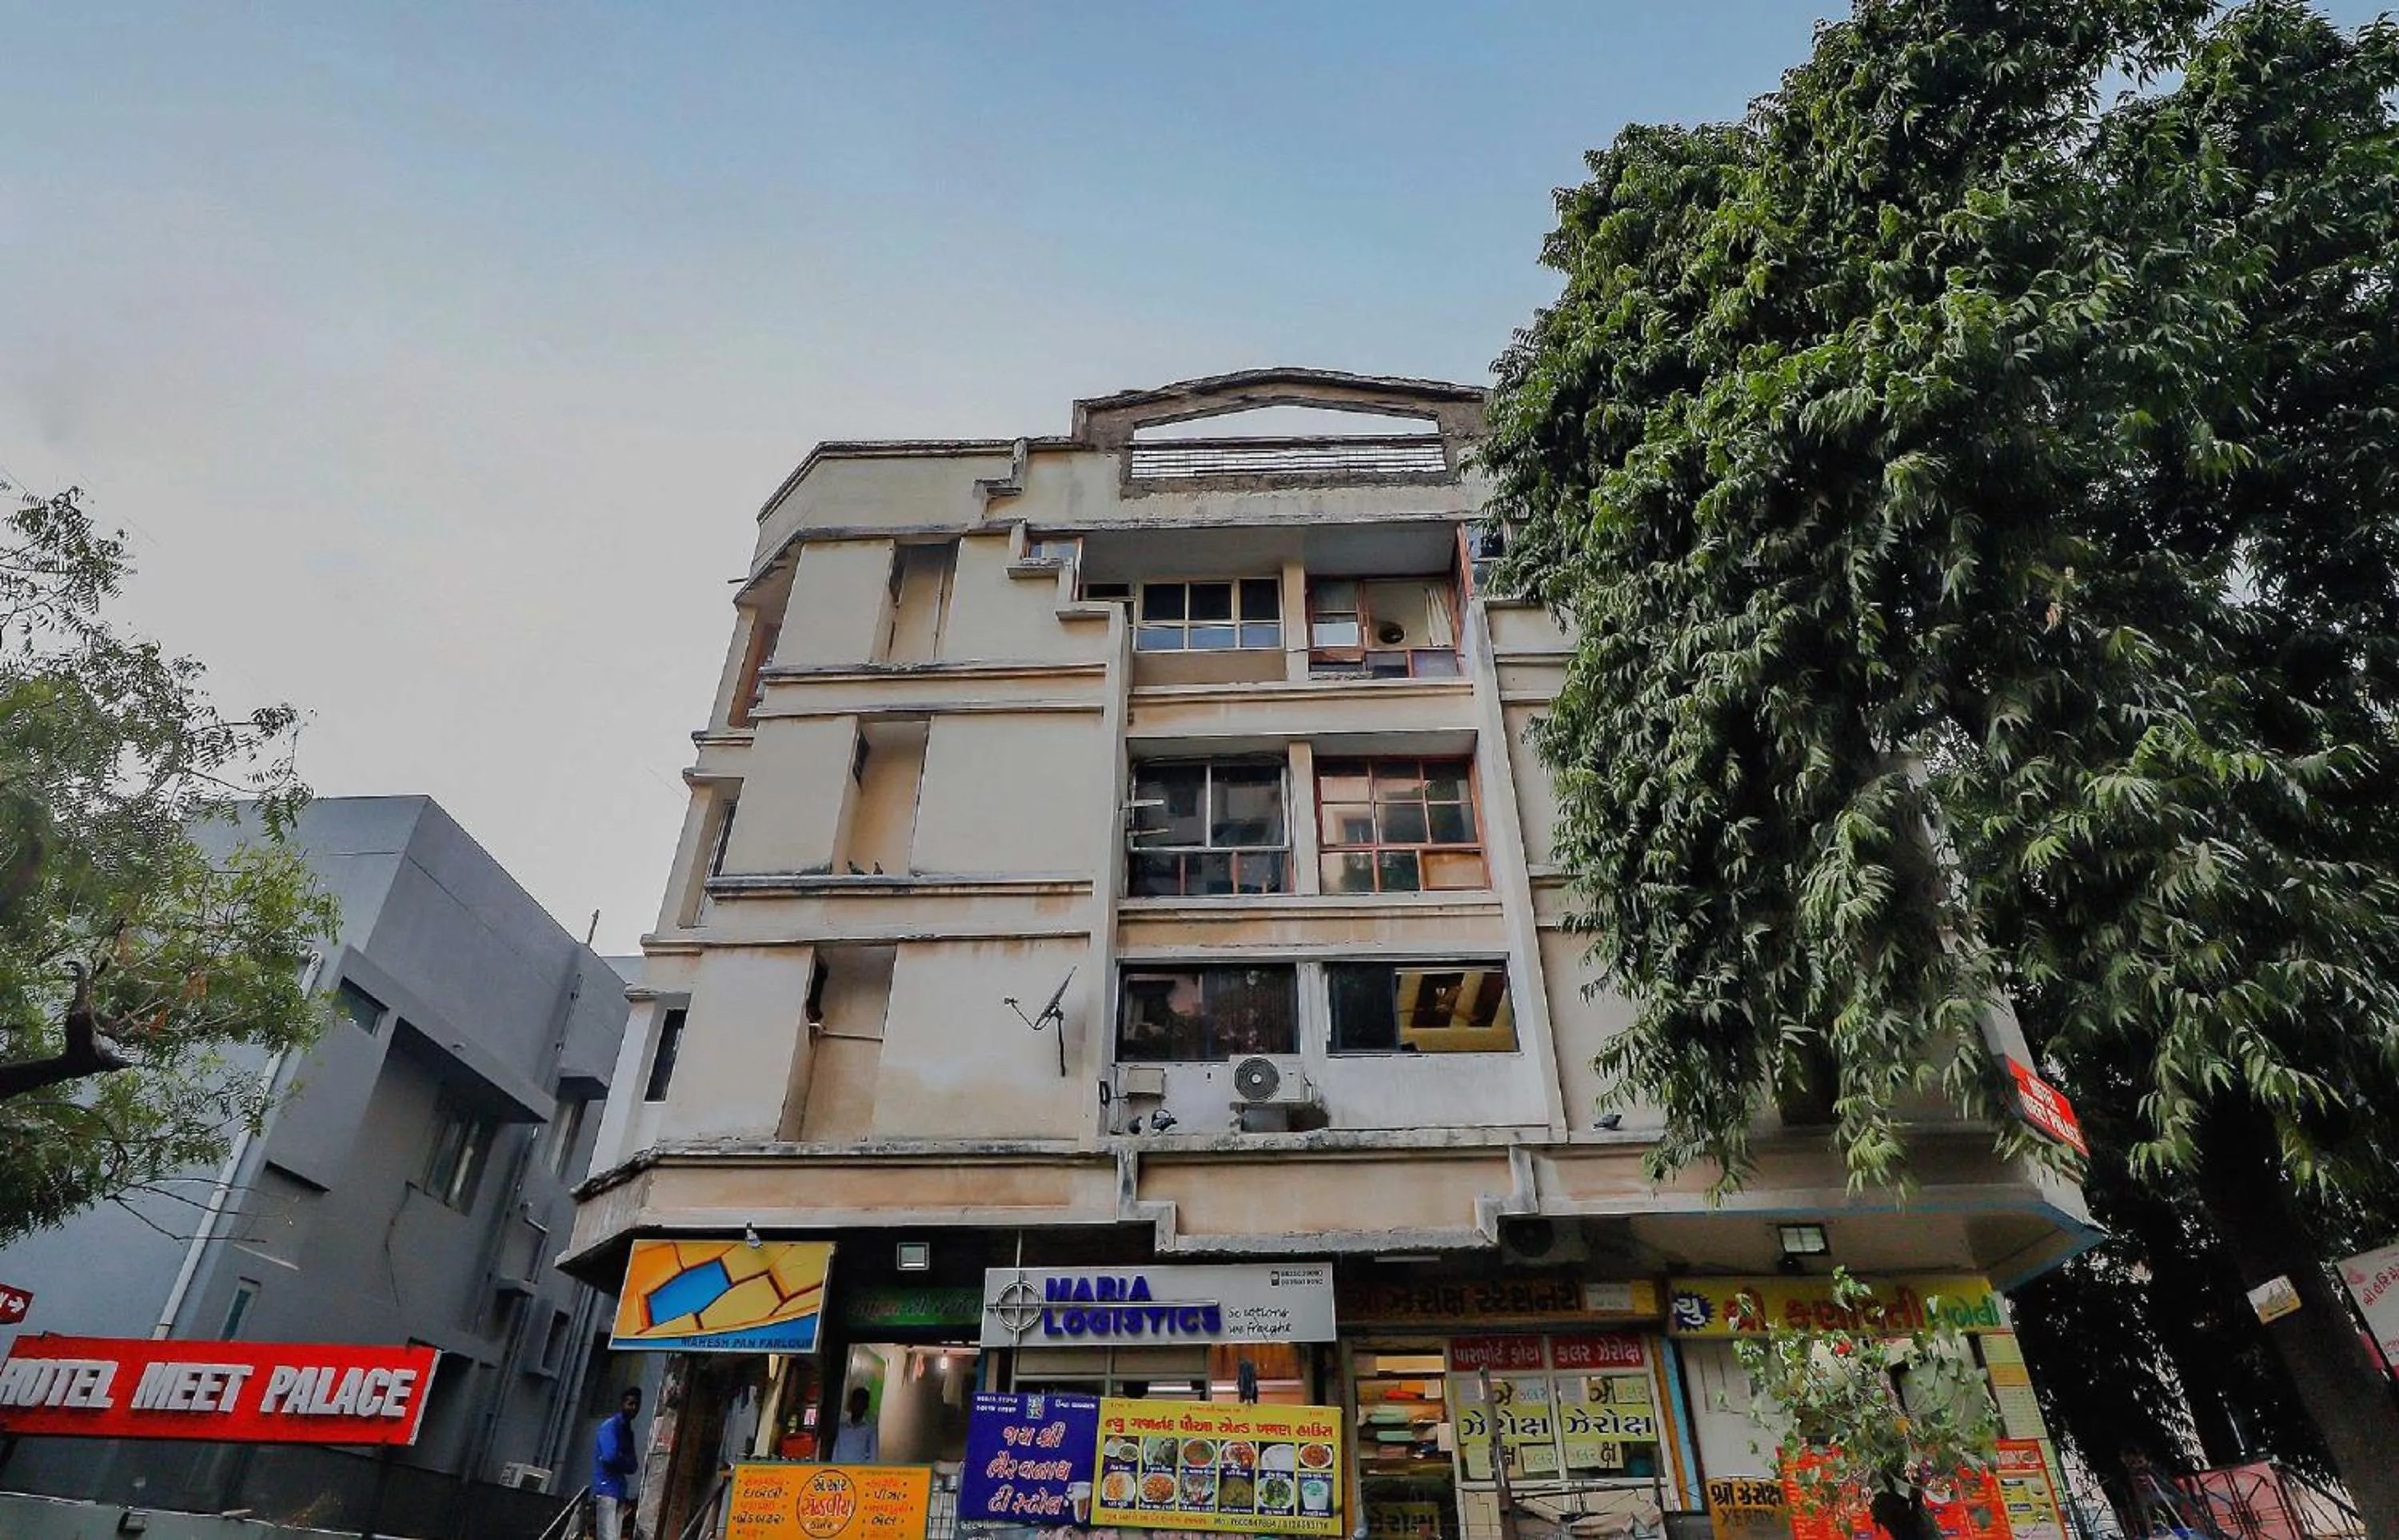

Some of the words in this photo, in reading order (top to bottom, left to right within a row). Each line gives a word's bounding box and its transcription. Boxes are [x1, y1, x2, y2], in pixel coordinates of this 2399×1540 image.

[1045, 1276, 1152, 1303] MARIA
[1043, 1307, 1221, 1335] LOGISTICS
[1, 1358, 119, 1408] HOTEL
[132, 1362, 253, 1412] MEET
[260, 1365, 417, 1418] PALACE
[1565, 1409, 1650, 1436] ઝેરોક્ષ
